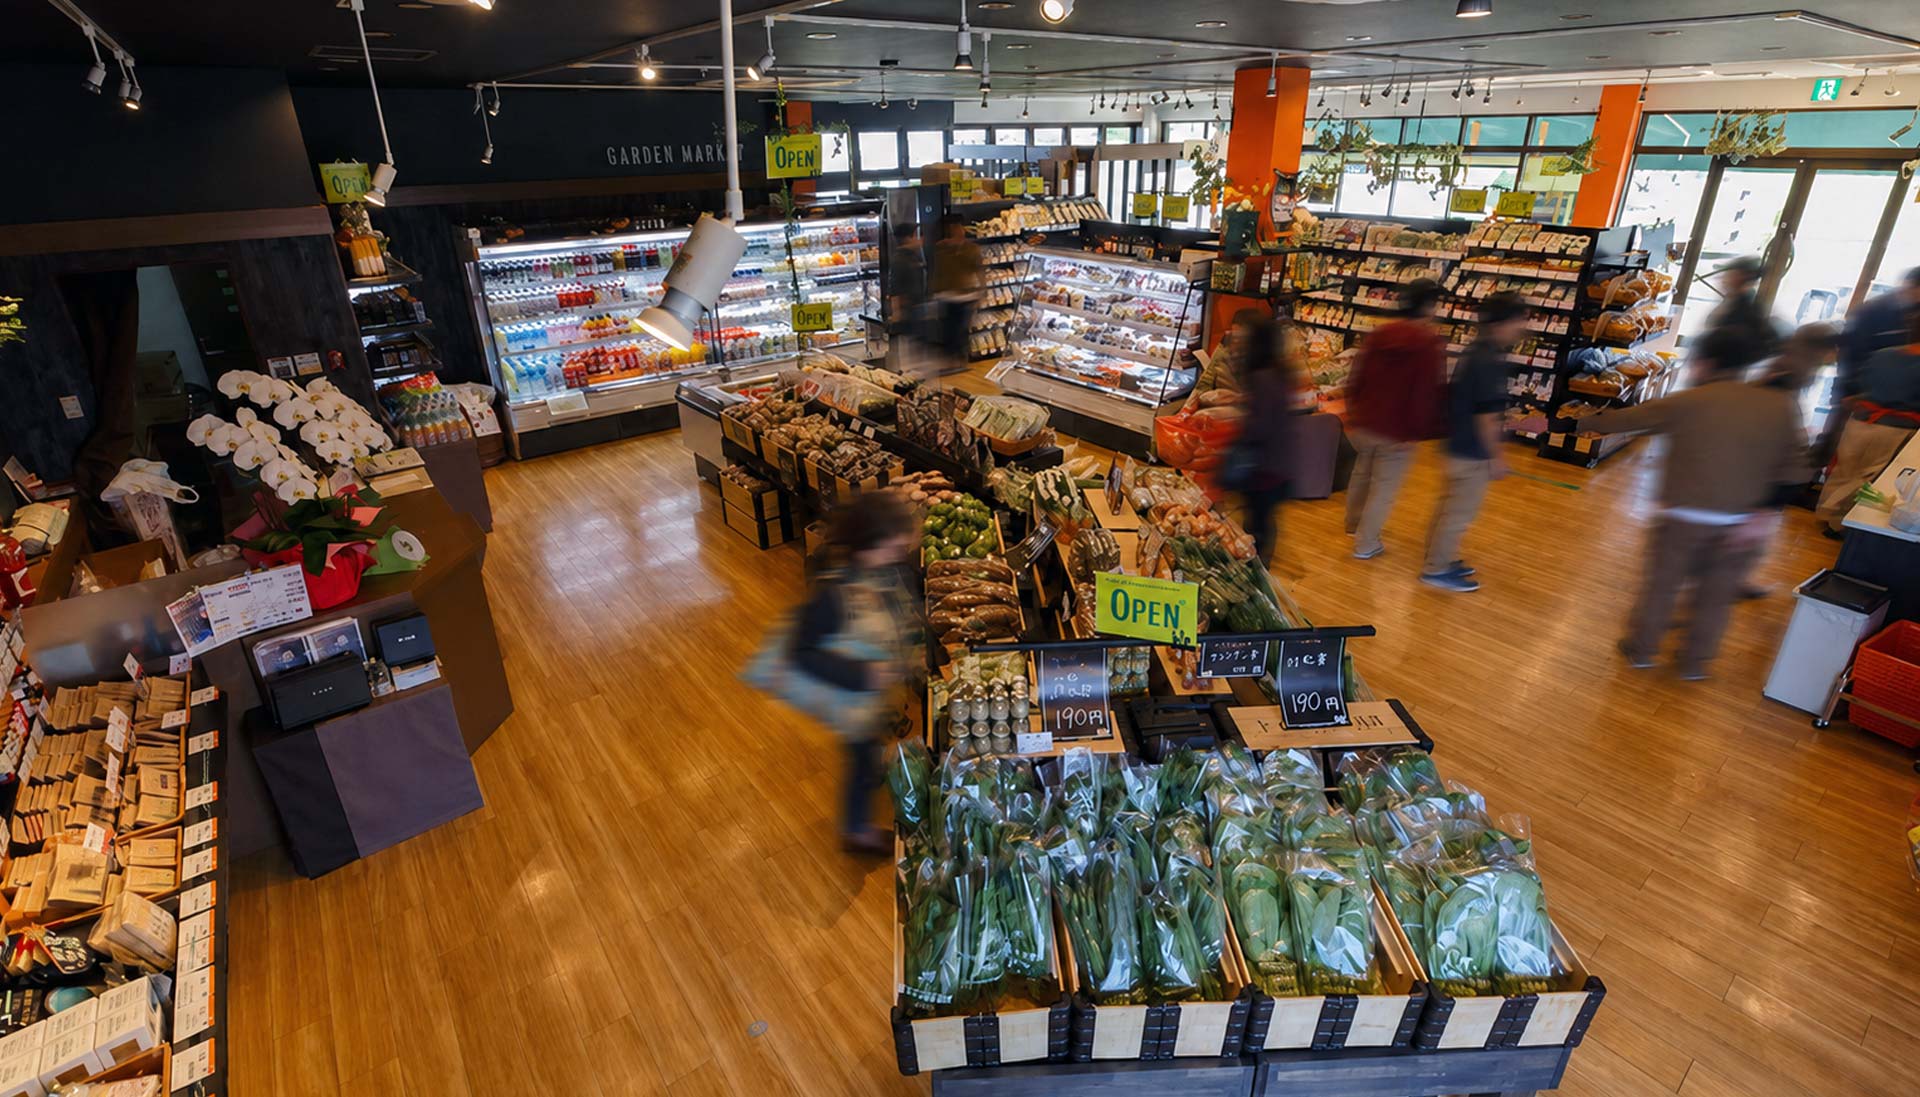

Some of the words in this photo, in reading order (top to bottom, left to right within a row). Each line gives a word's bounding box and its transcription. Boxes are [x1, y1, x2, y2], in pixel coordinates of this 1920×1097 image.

[607, 145, 673, 165] GARDEN
[681, 144, 743, 162] MARKT
[775, 146, 814, 168] OPEN
[797, 310, 826, 325] OPEN
[1111, 588, 1179, 629] OPEN
